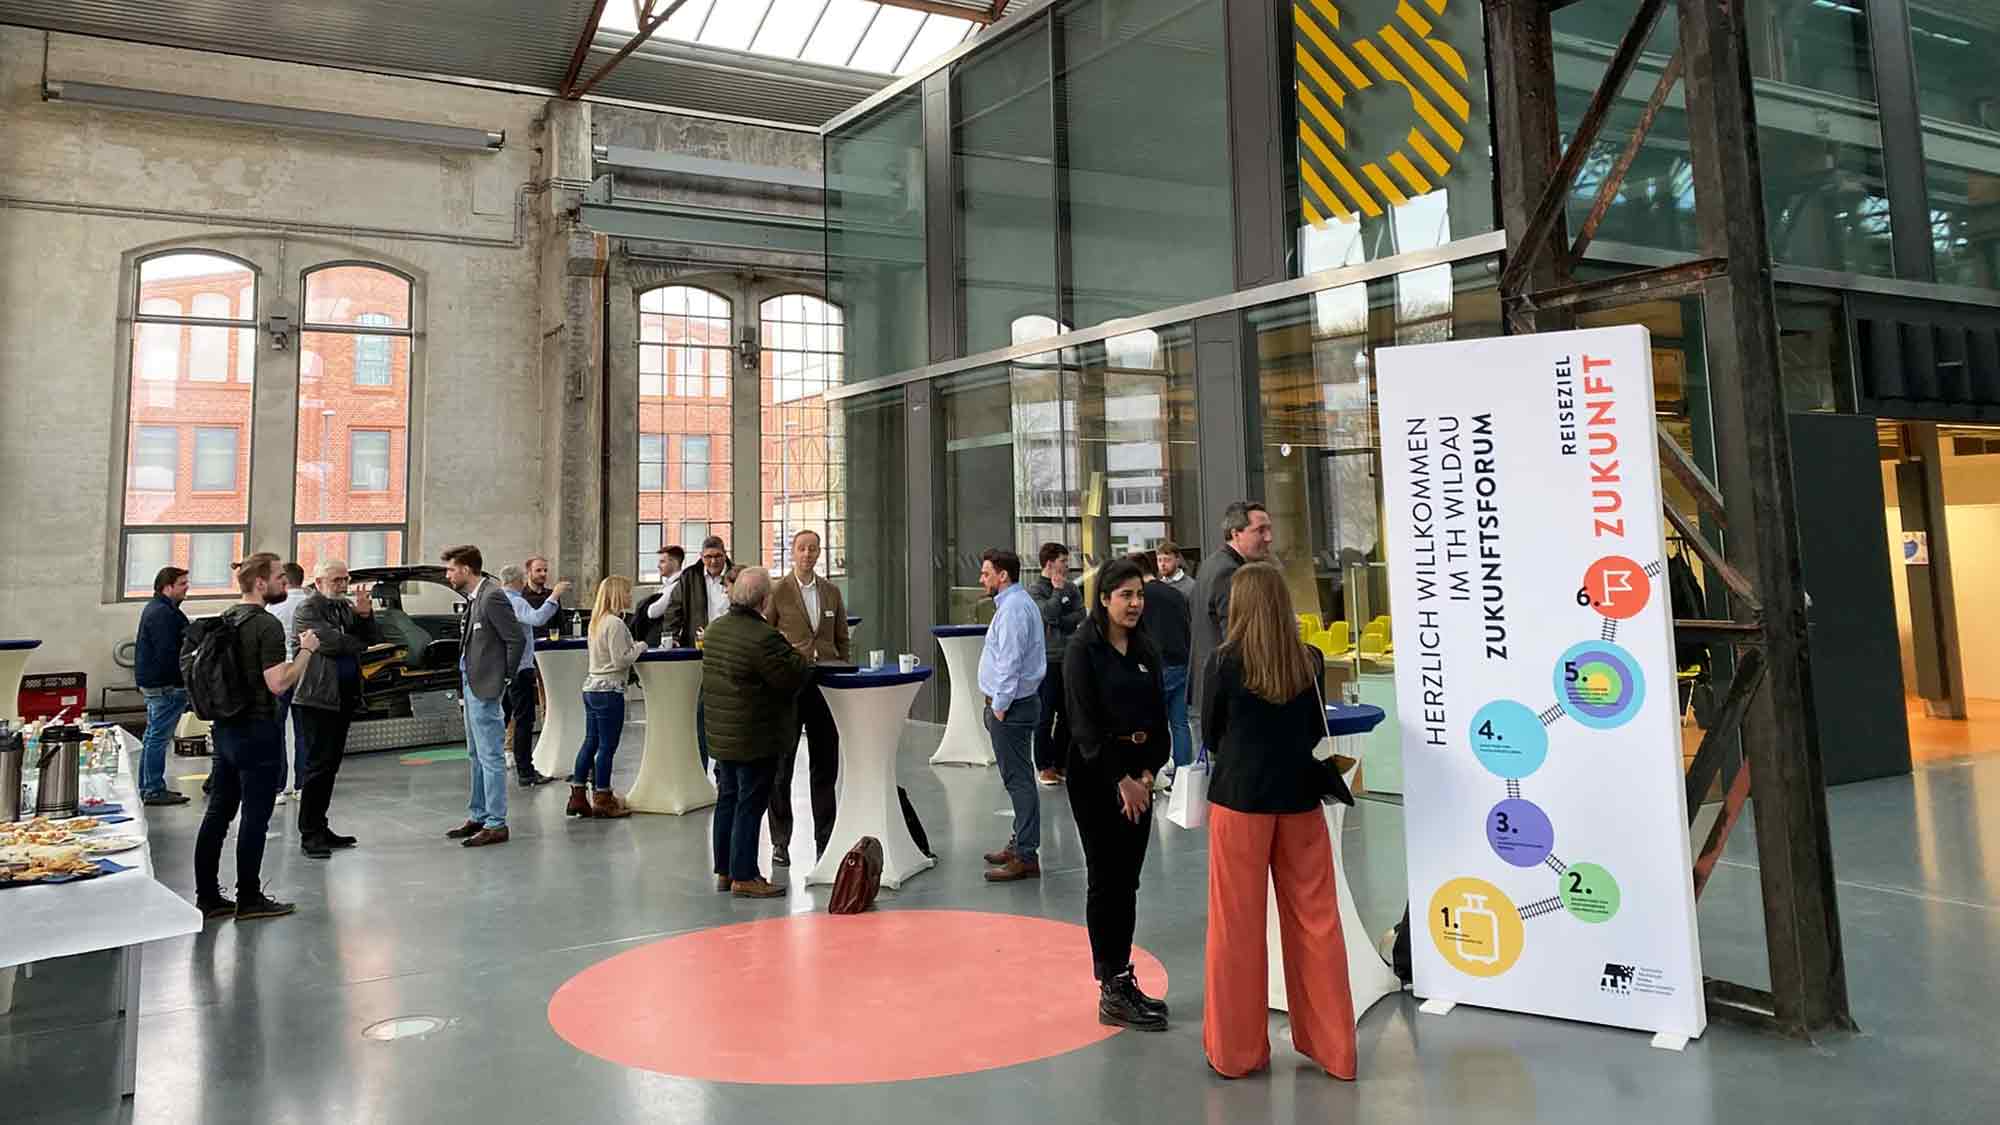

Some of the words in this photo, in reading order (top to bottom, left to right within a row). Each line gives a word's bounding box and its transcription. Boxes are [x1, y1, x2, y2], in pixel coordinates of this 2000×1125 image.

[1555, 355, 1577, 456] REISEZIEL
[1582, 354, 1625, 537] ZUKUNFT
[1439, 416, 1466, 520] WILDAU
[1407, 417, 1437, 601] WILLKOMMEN
[1447, 529, 1469, 563] TH
[1472, 412, 1508, 659] ZUKUNFTSFORUM
[1449, 571, 1471, 600] IM
[1576, 586, 1600, 607] 6.
[1418, 611, 1447, 745] HERZLICH
[1565, 661, 1588, 682] 5.
[1478, 719, 1503, 740] 4.
[1495, 811, 1519, 834] 3.
[1568, 871, 1592, 895] 2.
[1441, 906, 1459, 929] 1.
